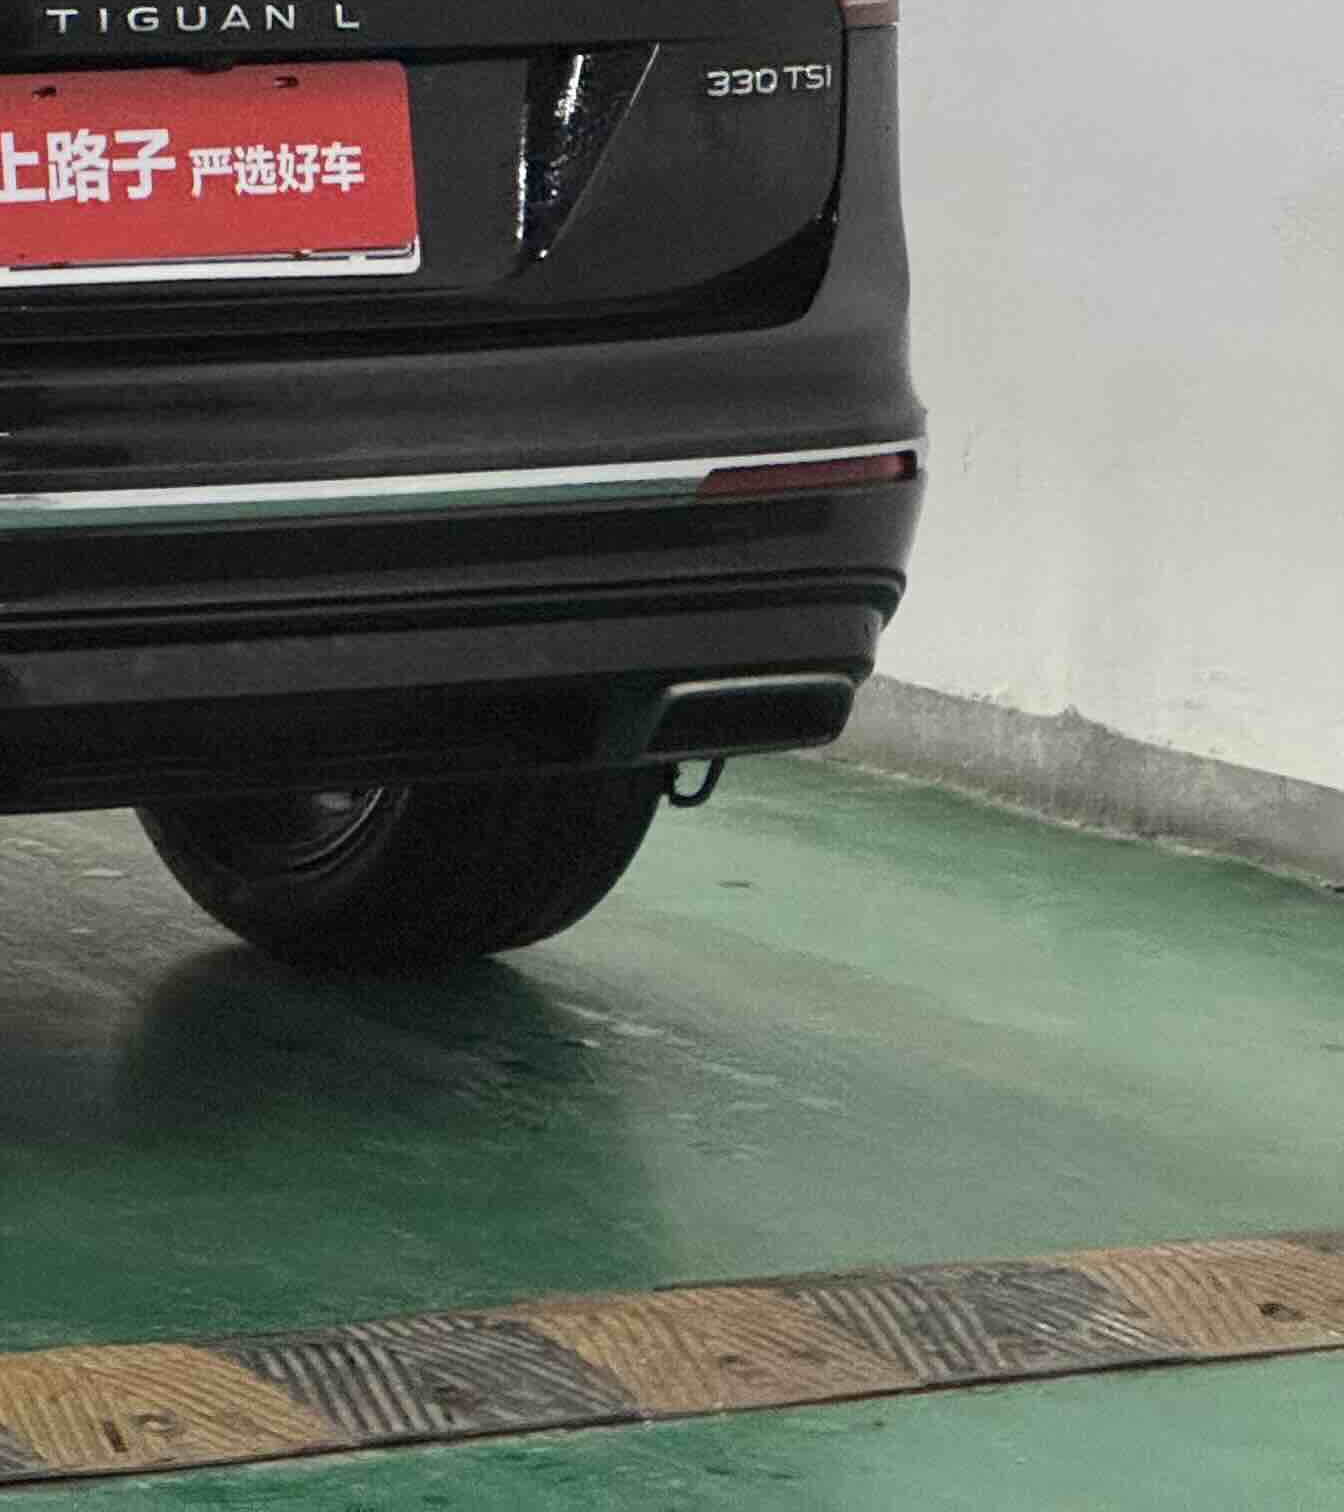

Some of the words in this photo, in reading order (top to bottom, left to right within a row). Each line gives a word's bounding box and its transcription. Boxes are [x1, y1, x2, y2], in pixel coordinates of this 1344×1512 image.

[46, 4, 295, 33] TIGUAN
[335, 3, 360, 29] L
[706, 68, 778, 96] 330
[783, 64, 832, 90] TSI
[188, 141, 366, 198] 严选好车
